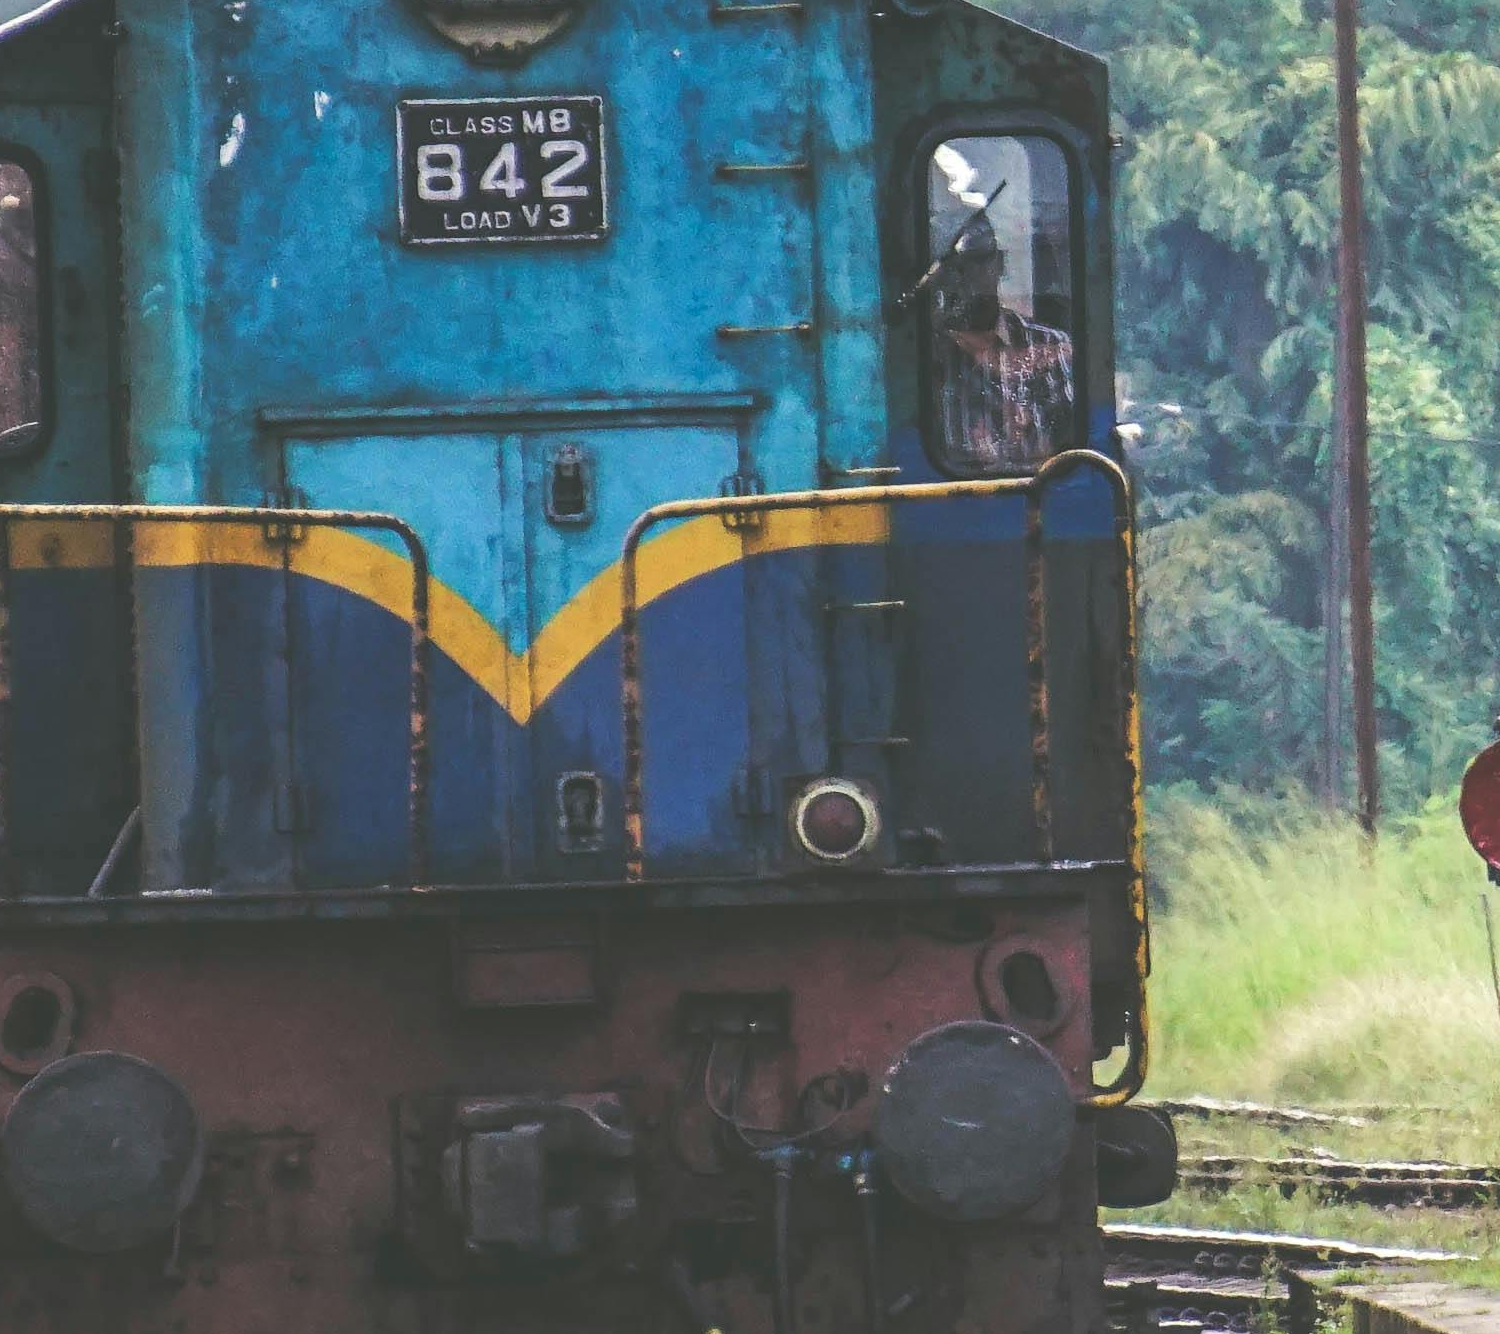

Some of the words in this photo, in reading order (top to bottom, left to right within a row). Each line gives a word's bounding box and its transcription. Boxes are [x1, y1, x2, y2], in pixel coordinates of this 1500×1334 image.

[429, 115, 513, 135] CLASS
[417, 139, 589, 201] 842
[443, 210, 511, 230] LOAD
[521, 203, 570, 228] V3
